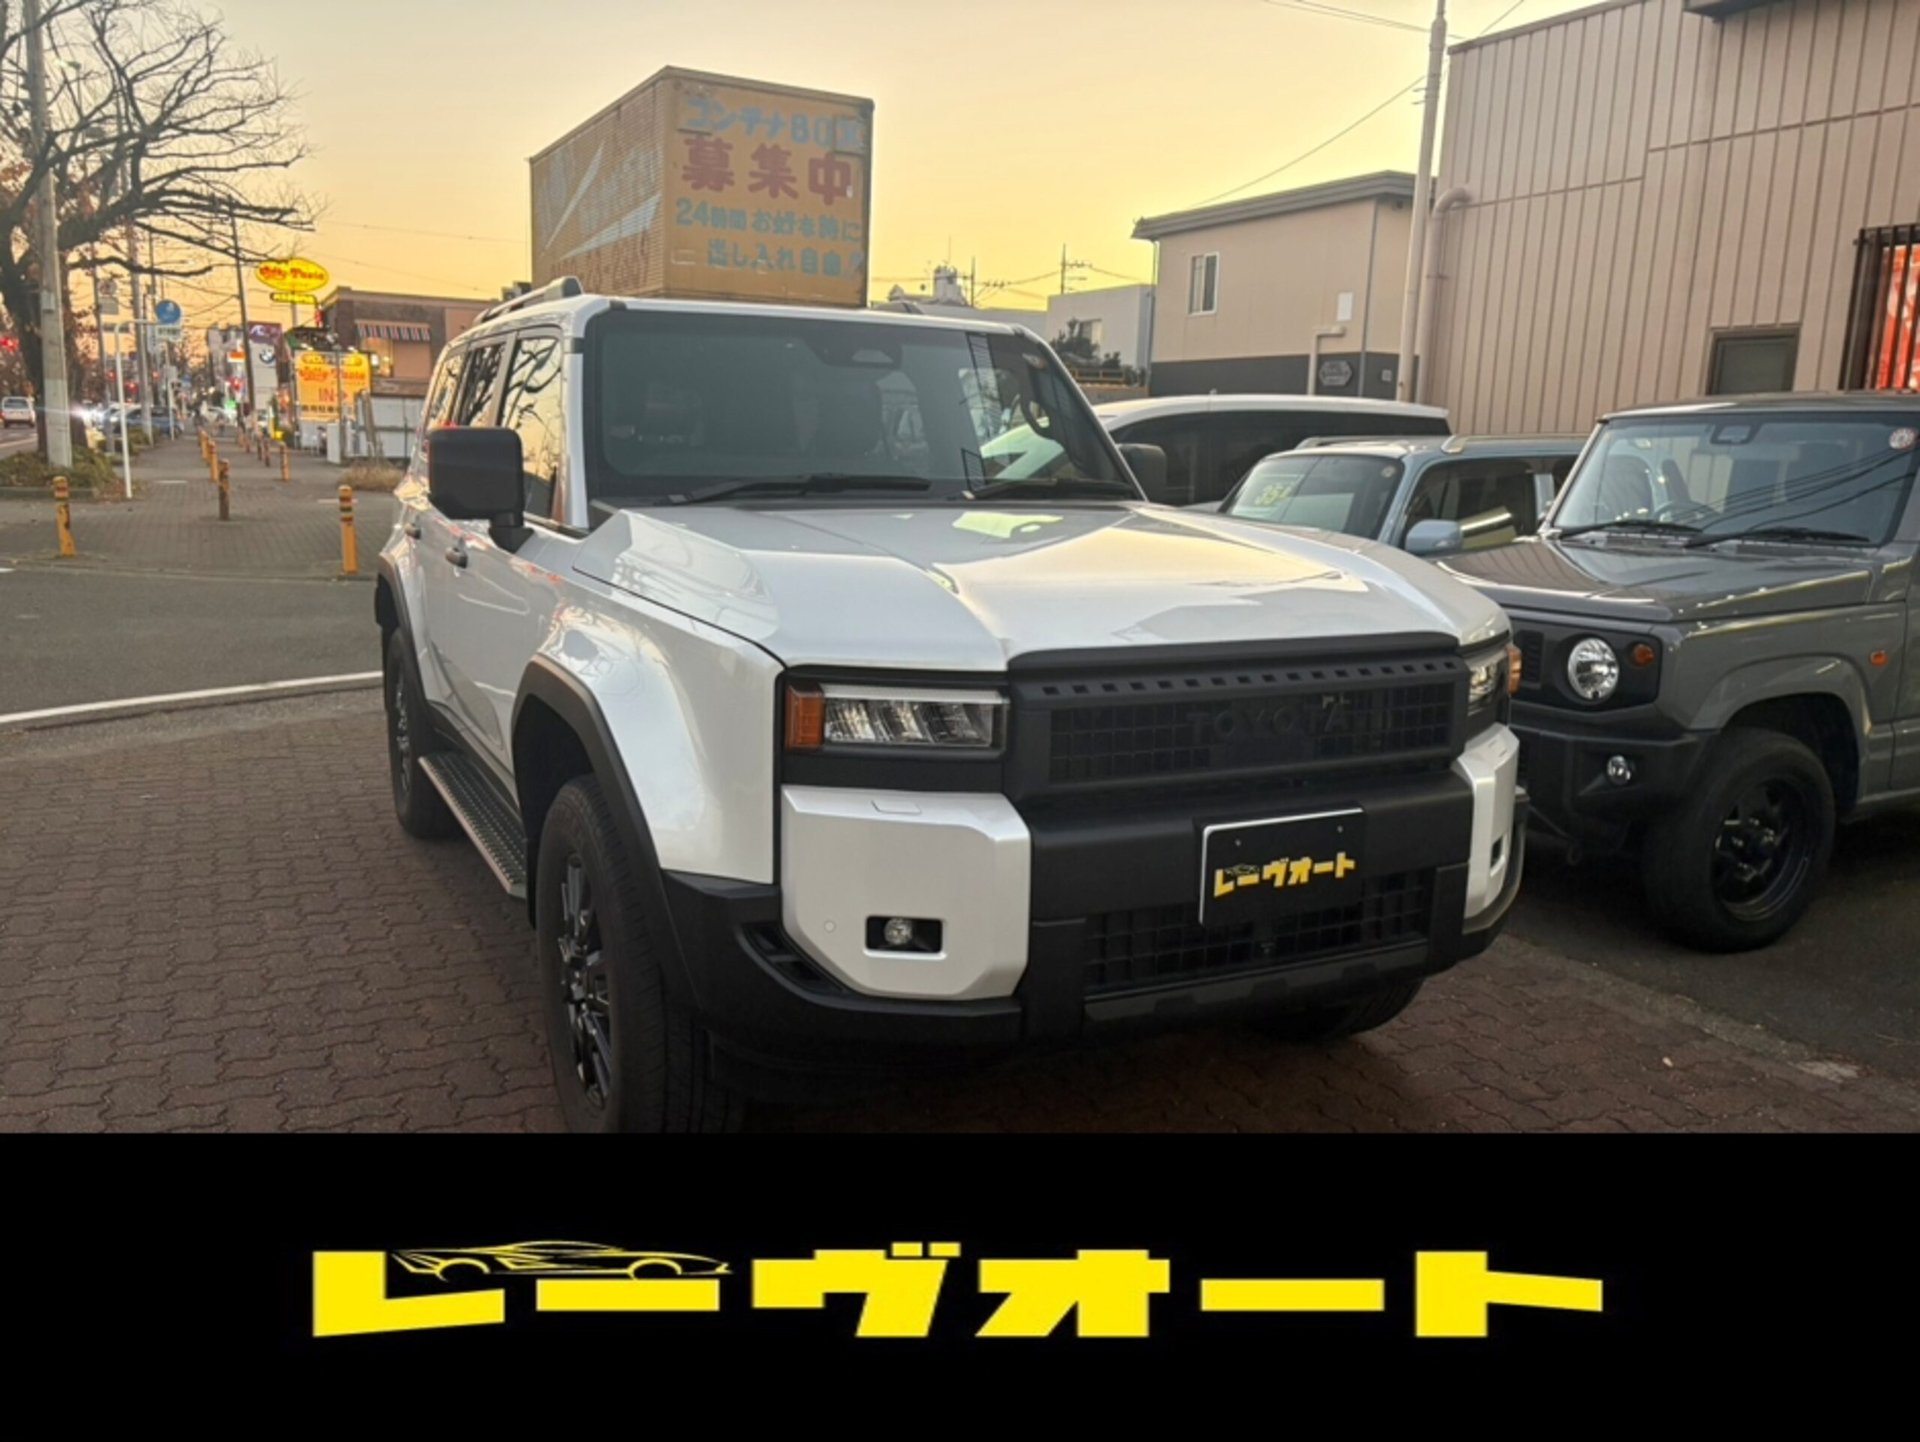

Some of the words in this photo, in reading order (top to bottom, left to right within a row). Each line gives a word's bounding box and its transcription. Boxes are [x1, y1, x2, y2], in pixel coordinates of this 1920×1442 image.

[682, 135, 852, 205] 募集中
[1186, 703, 1351, 740] TOYOTA
[1214, 852, 1355, 896] レーヴオート
